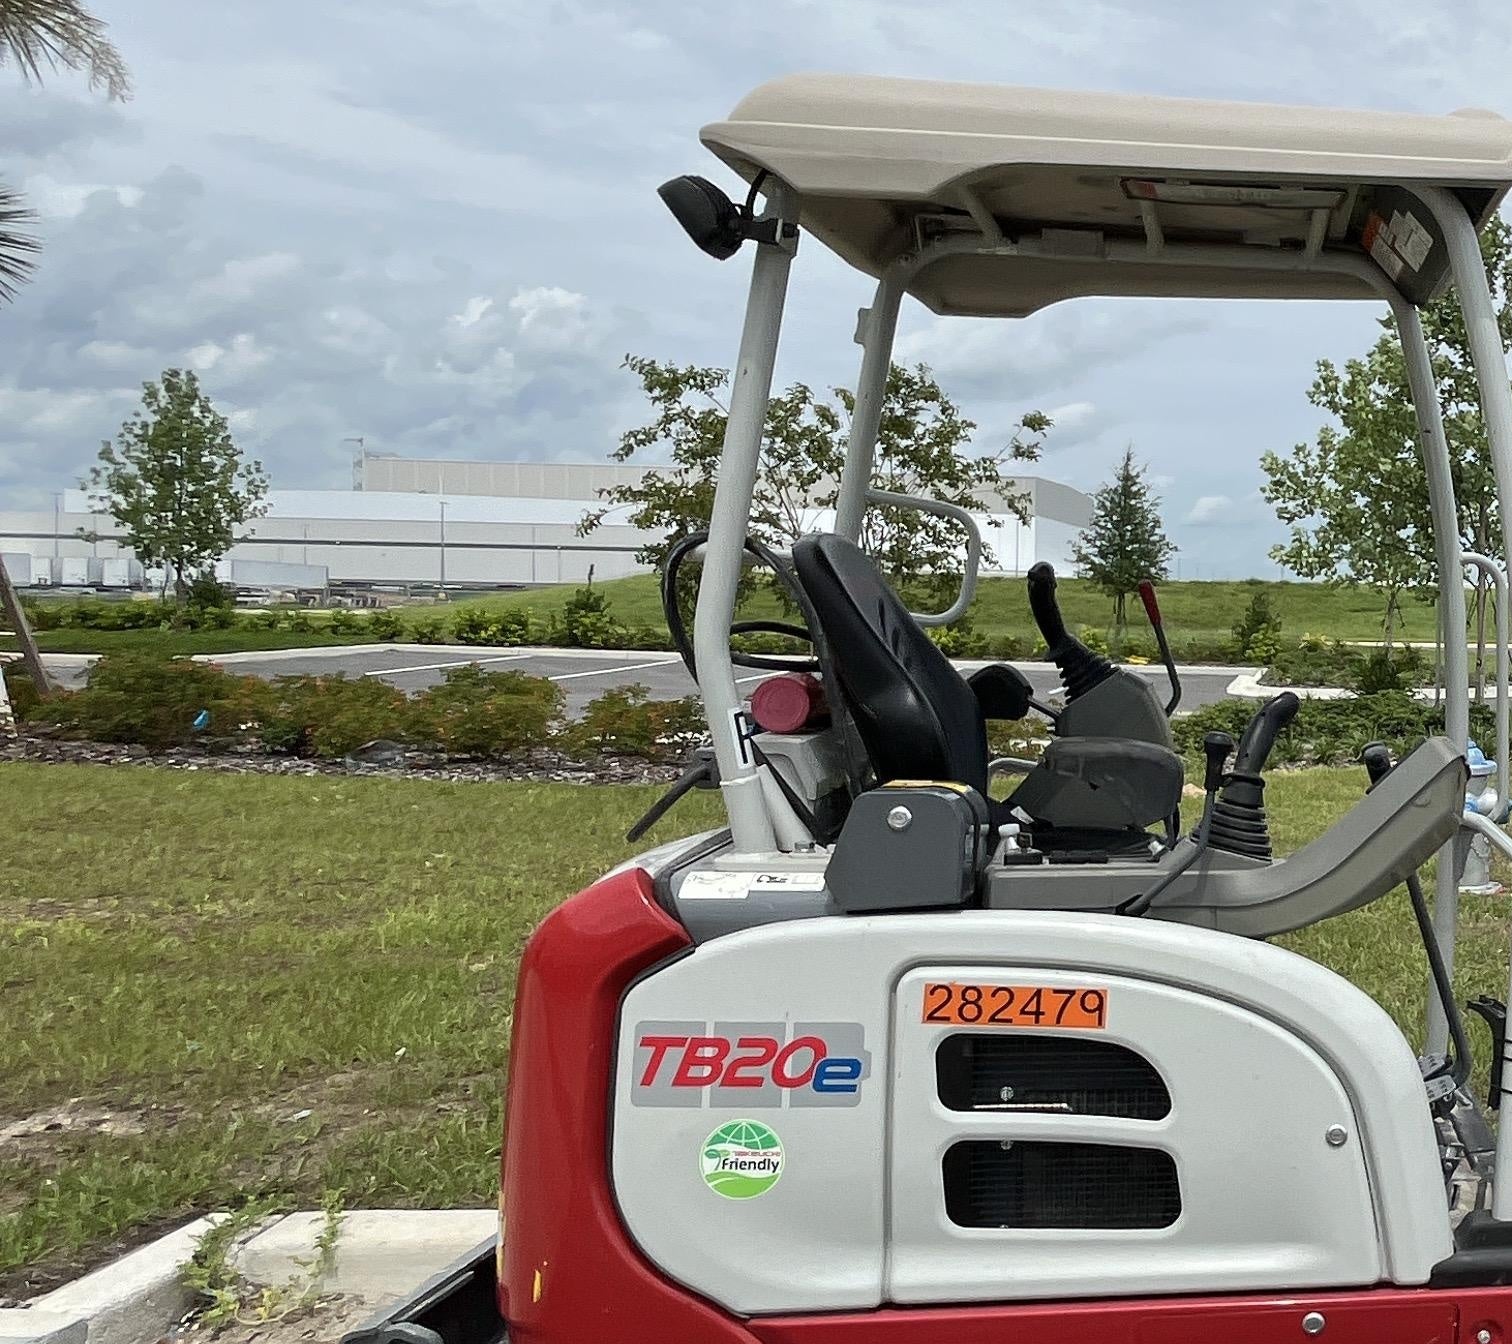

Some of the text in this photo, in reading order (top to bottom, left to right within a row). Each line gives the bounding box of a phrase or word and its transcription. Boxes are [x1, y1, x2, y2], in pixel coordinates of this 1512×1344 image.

[924, 983, 1105, 1025] 282479
[638, 1036, 862, 1094] TB20e
[721, 1157, 780, 1173] Friendly
